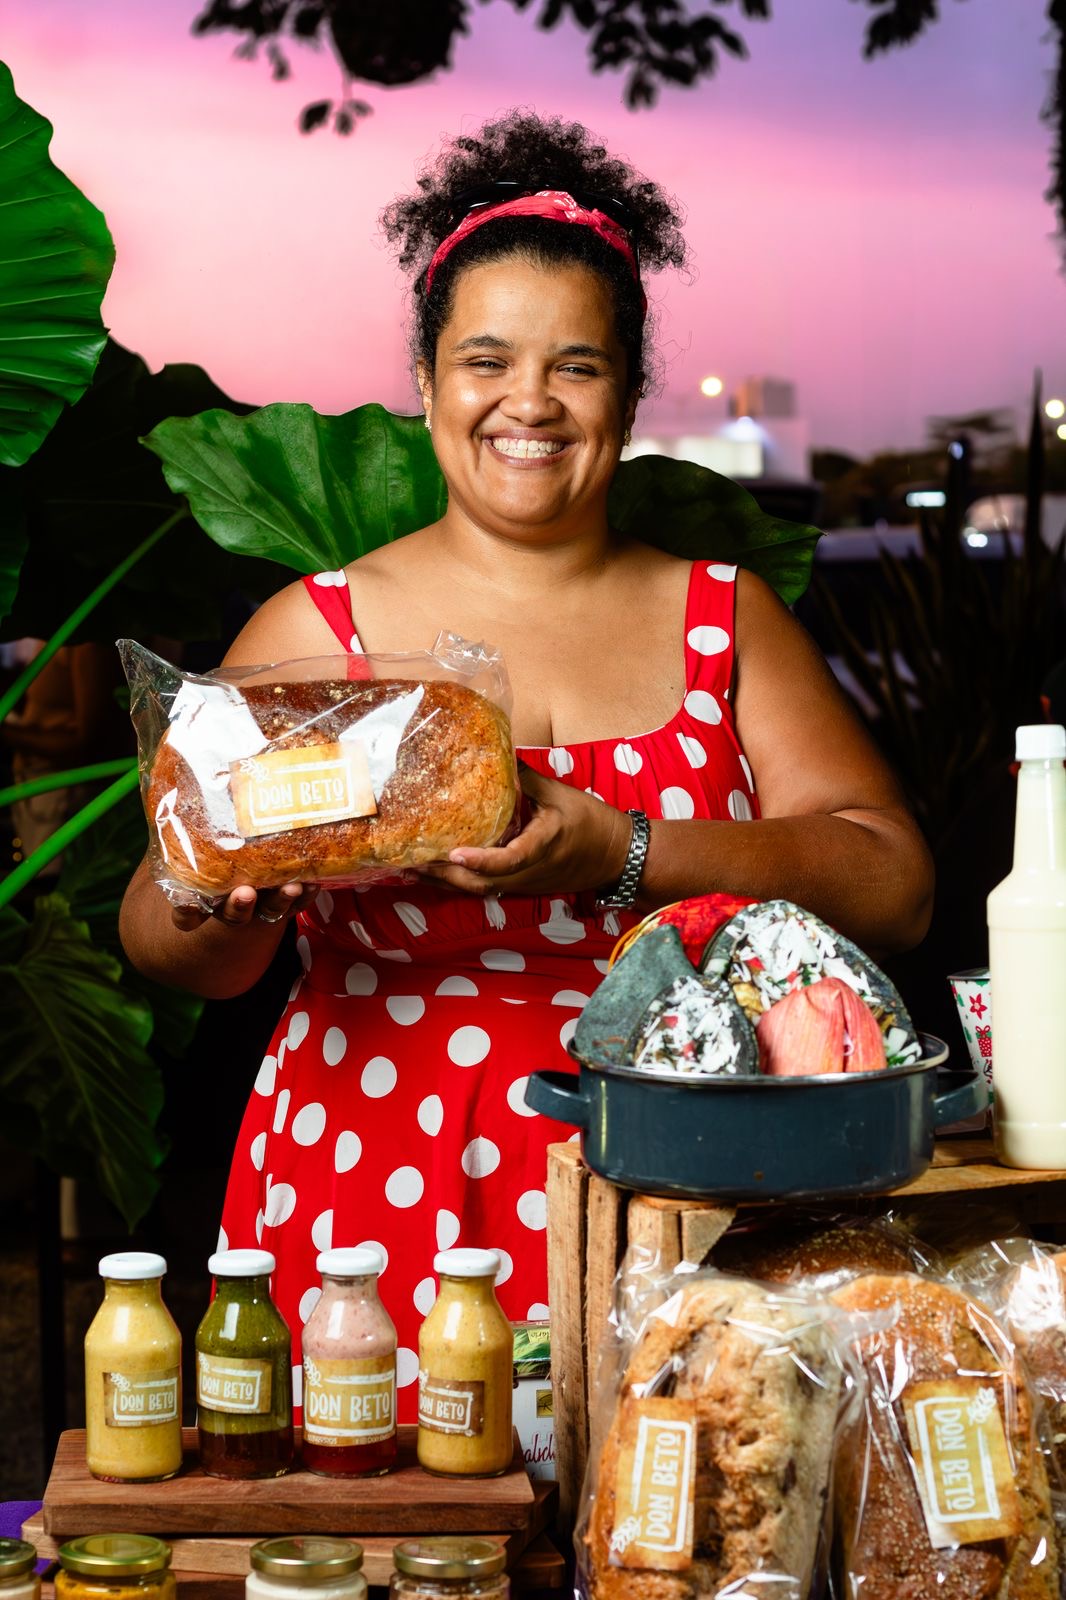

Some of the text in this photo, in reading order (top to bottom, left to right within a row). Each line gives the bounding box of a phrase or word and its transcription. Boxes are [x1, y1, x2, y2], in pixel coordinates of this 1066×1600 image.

[258, 777, 344, 812] DON BETO
[121, 1391, 174, 1412] DON BETO
[202, 1375, 253, 1400] DON BETO
[310, 1391, 390, 1423] DON BETO
[436, 1400, 465, 1420] BETO
[932, 1407, 977, 1512] DON BETO
[646, 1431, 682, 1540] DON BETO
